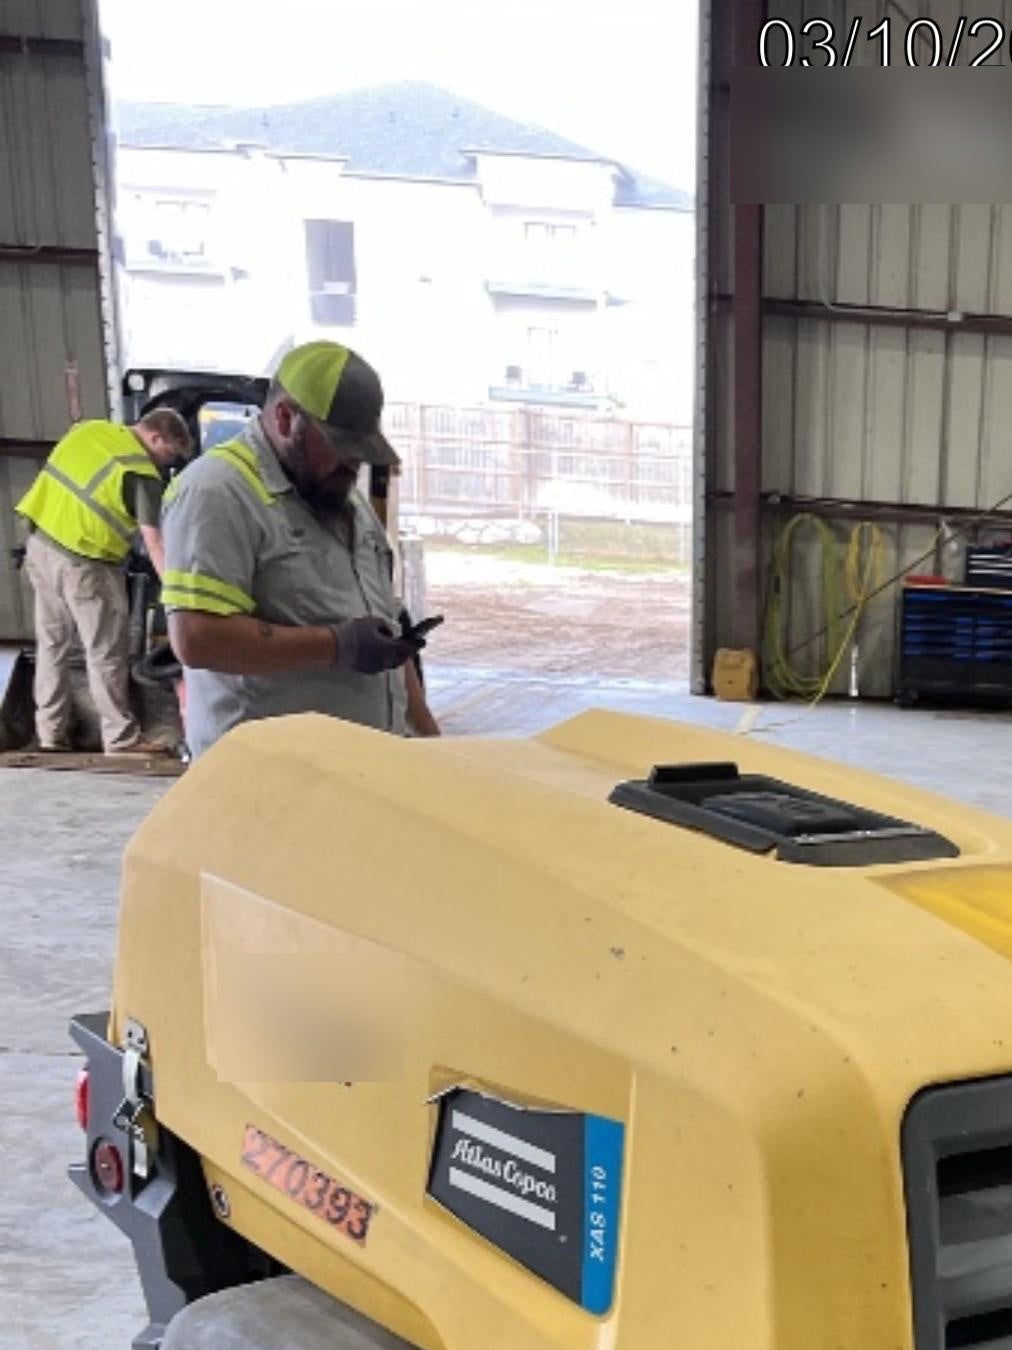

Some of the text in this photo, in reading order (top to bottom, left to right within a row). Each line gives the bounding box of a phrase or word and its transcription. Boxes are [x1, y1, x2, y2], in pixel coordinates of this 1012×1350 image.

[242, 1131, 373, 1240] 270393
[590, 1165, 608, 1261] XAS 110
